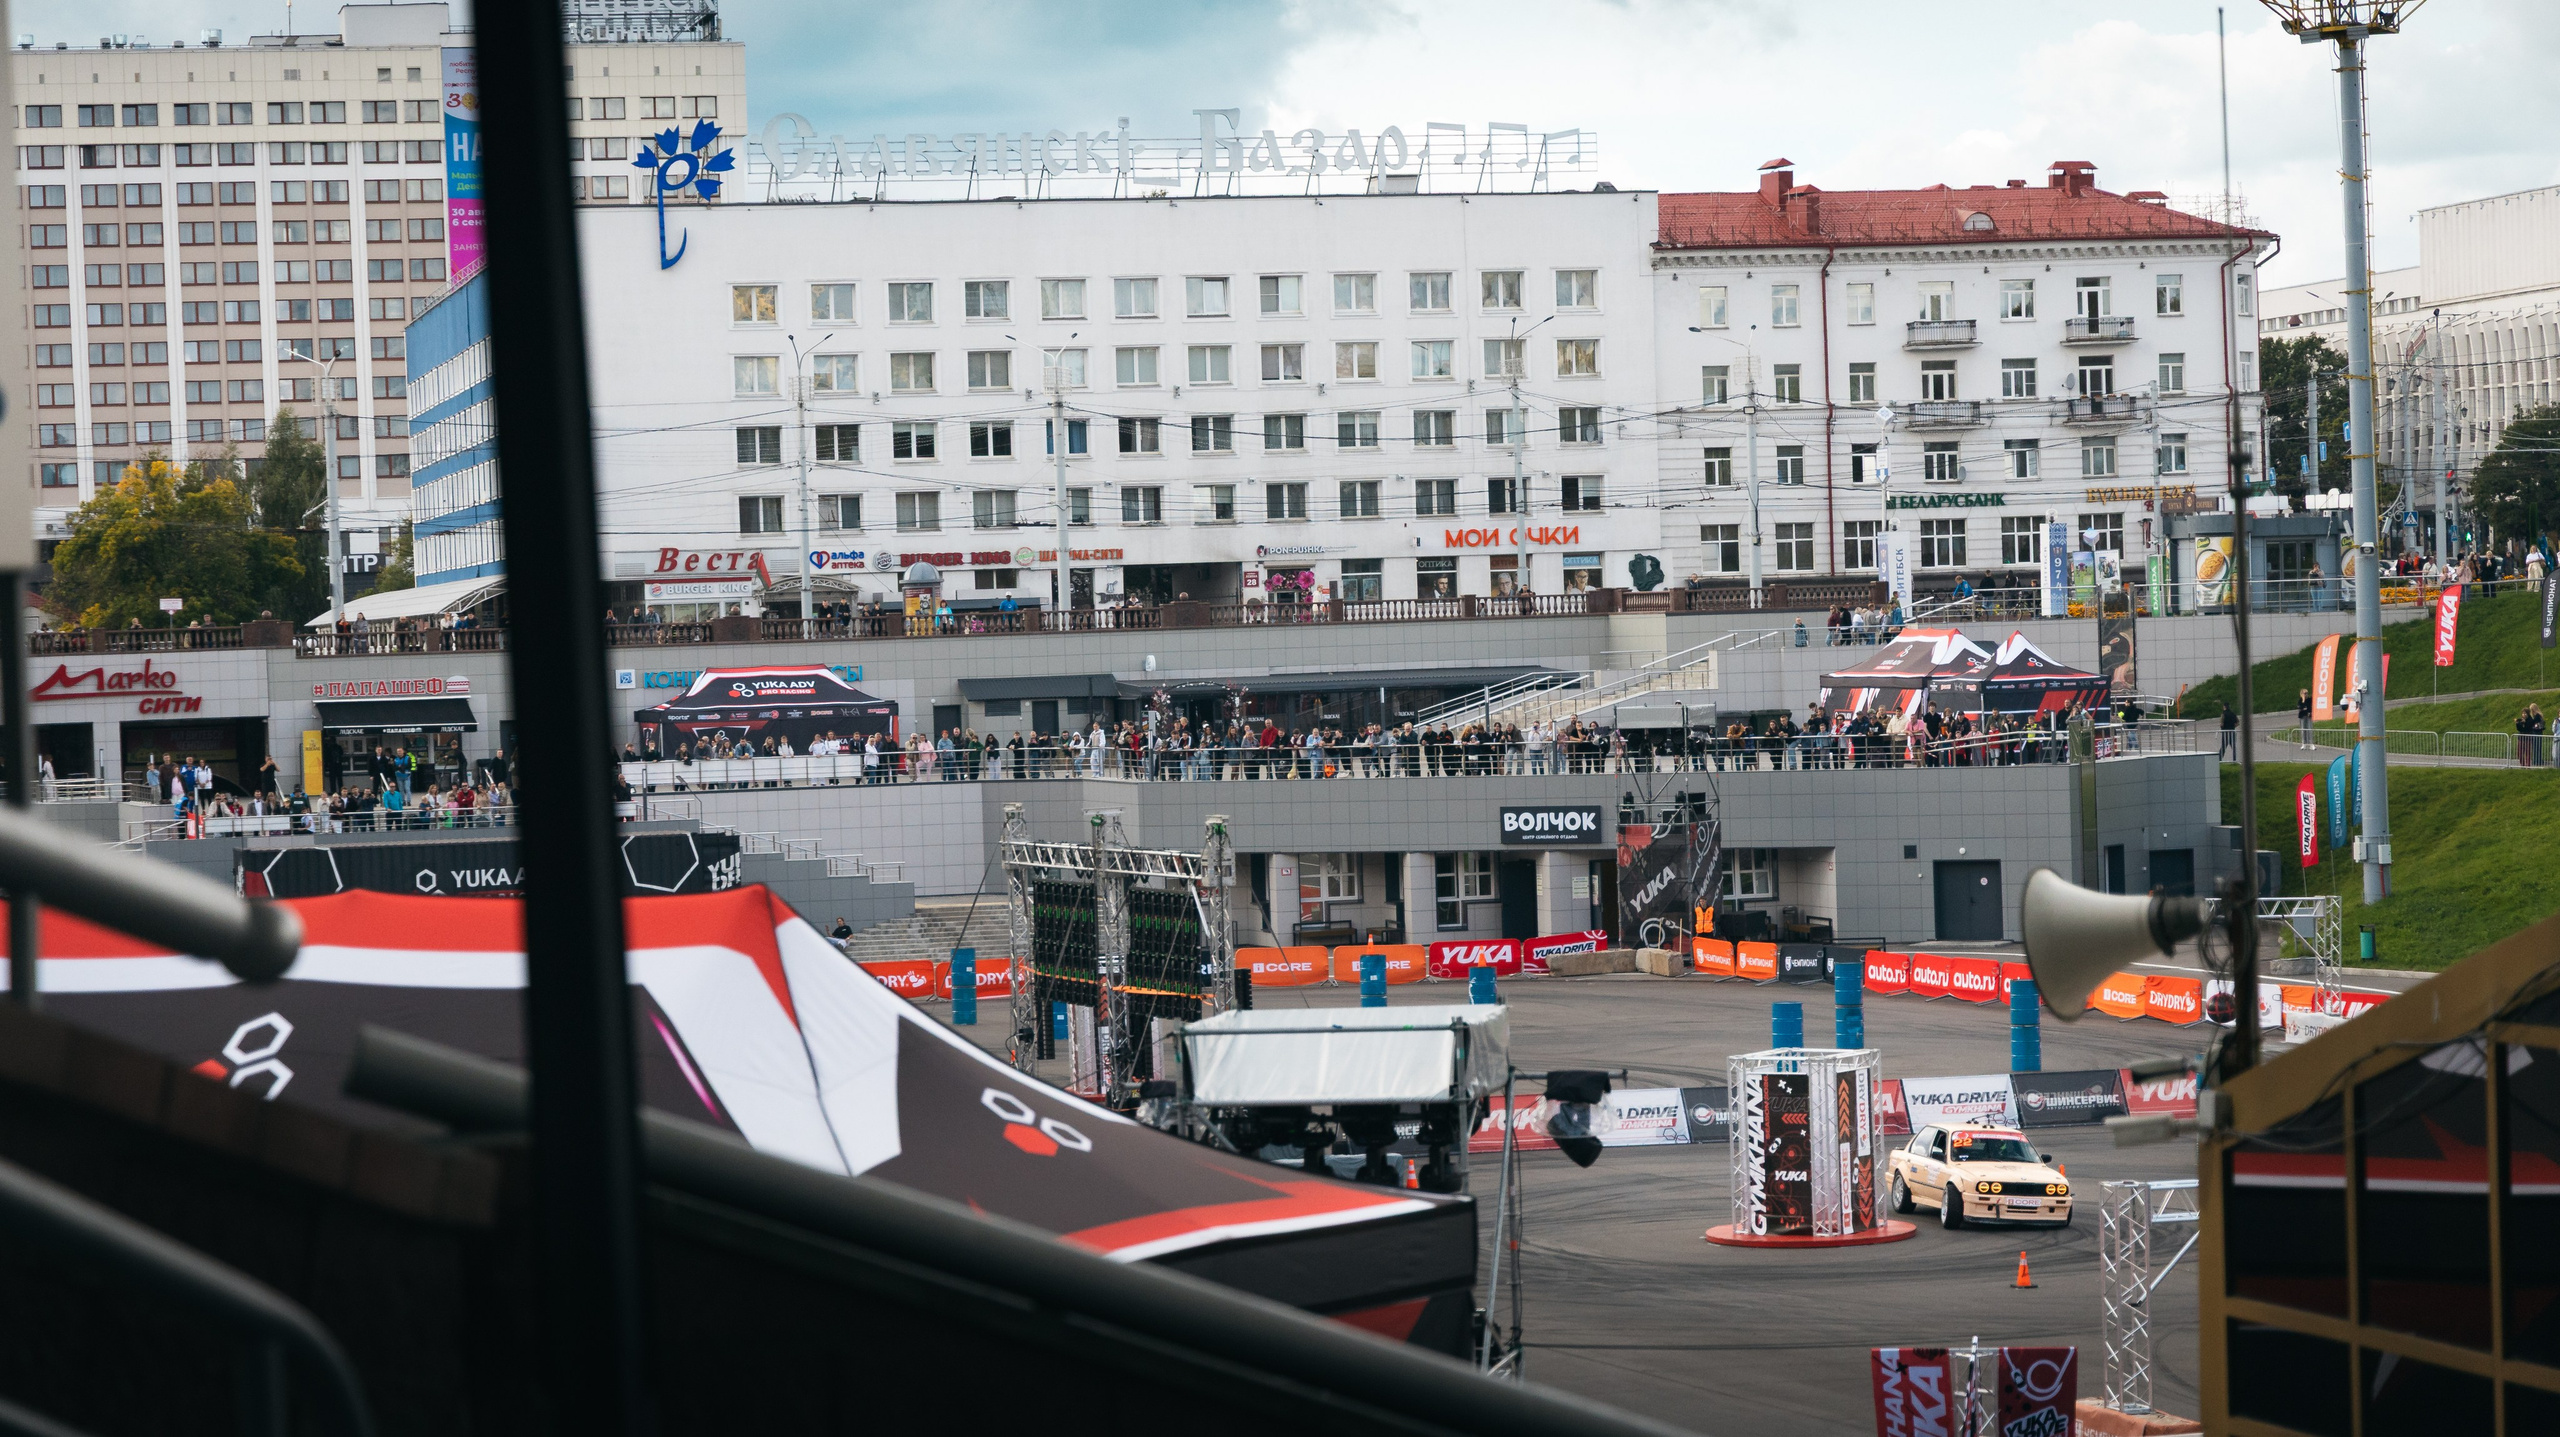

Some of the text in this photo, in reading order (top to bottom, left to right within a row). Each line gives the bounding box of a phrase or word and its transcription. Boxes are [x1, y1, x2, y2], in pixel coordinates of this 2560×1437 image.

[1192, 107, 1409, 192] Базар
[452, 208, 465, 216] 30
[1900, 493, 2007, 509] БЕЛАРУСБАНК
[1445, 528, 1500, 548] МОИ
[831, 550, 865, 560] альфа
[971, 551, 1011, 564] KING
[1269, 546, 1326, 555] PON-PUSHKA
[654, 547, 762, 572] Веста
[831, 561, 865, 569] аптека
[1418, 560, 1453, 568] ОПТИКА
[1564, 556, 1599, 564] ОПТИКА
[667, 582, 749, 594] BURGER KING
[2151, 565, 2159, 611] DARIDA
[2546, 578, 2557, 627] ЧЕМПИОНАТ
[2440, 595, 2458, 652] YUKA
[29, 658, 177, 691] Марко
[2318, 645, 2332, 695] CORE
[752, 681, 815, 689] YUKA ADV
[2333, 774, 2342, 824] PRESIDENT
[1503, 812, 1596, 831] ВОЛЧОК
[2302, 793, 2311, 854] YUKA DRIVE
[452, 868, 511, 887] YUKA
[1629, 866, 1676, 913] YUKA
[1442, 945, 1513, 965] YUKA
[1534, 942, 1595, 959] YUKA DRIVE
[1266, 962, 1312, 972] CORE
[1703, 953, 1732, 966] ЧЕМПИОНАТ
[1746, 957, 1774, 968] ЧЕМПИОНАТ
[1791, 958, 1818, 967] ЧЕМПИОНАТ
[1868, 964, 1906, 983] auto.ru
[1913, 966, 1949, 987] auto.ru
[1953, 971, 1996, 991] auto.ru
[2111, 991, 2136, 1004] CORE
[1858, 1073, 1867, 1131] DRYDRY
[1911, 1090, 2008, 1105] YUKA DRIVE
[2045, 1093, 2120, 1106] ШИНСЕРВИС
[1626, 1105, 1678, 1120] DRIVE
[1945, 1103, 2004, 1114] GYMKHANA
[1953, 1138, 1973, 1148] 22
[1746, 1075, 1767, 1236] GYMKHANA
[1774, 1170, 1808, 1182] YUKA
[1841, 1149, 1850, 1210] CORE
[2015, 1198, 2040, 1206] CORE
[2006, 1407, 2057, 1437] YUKA
